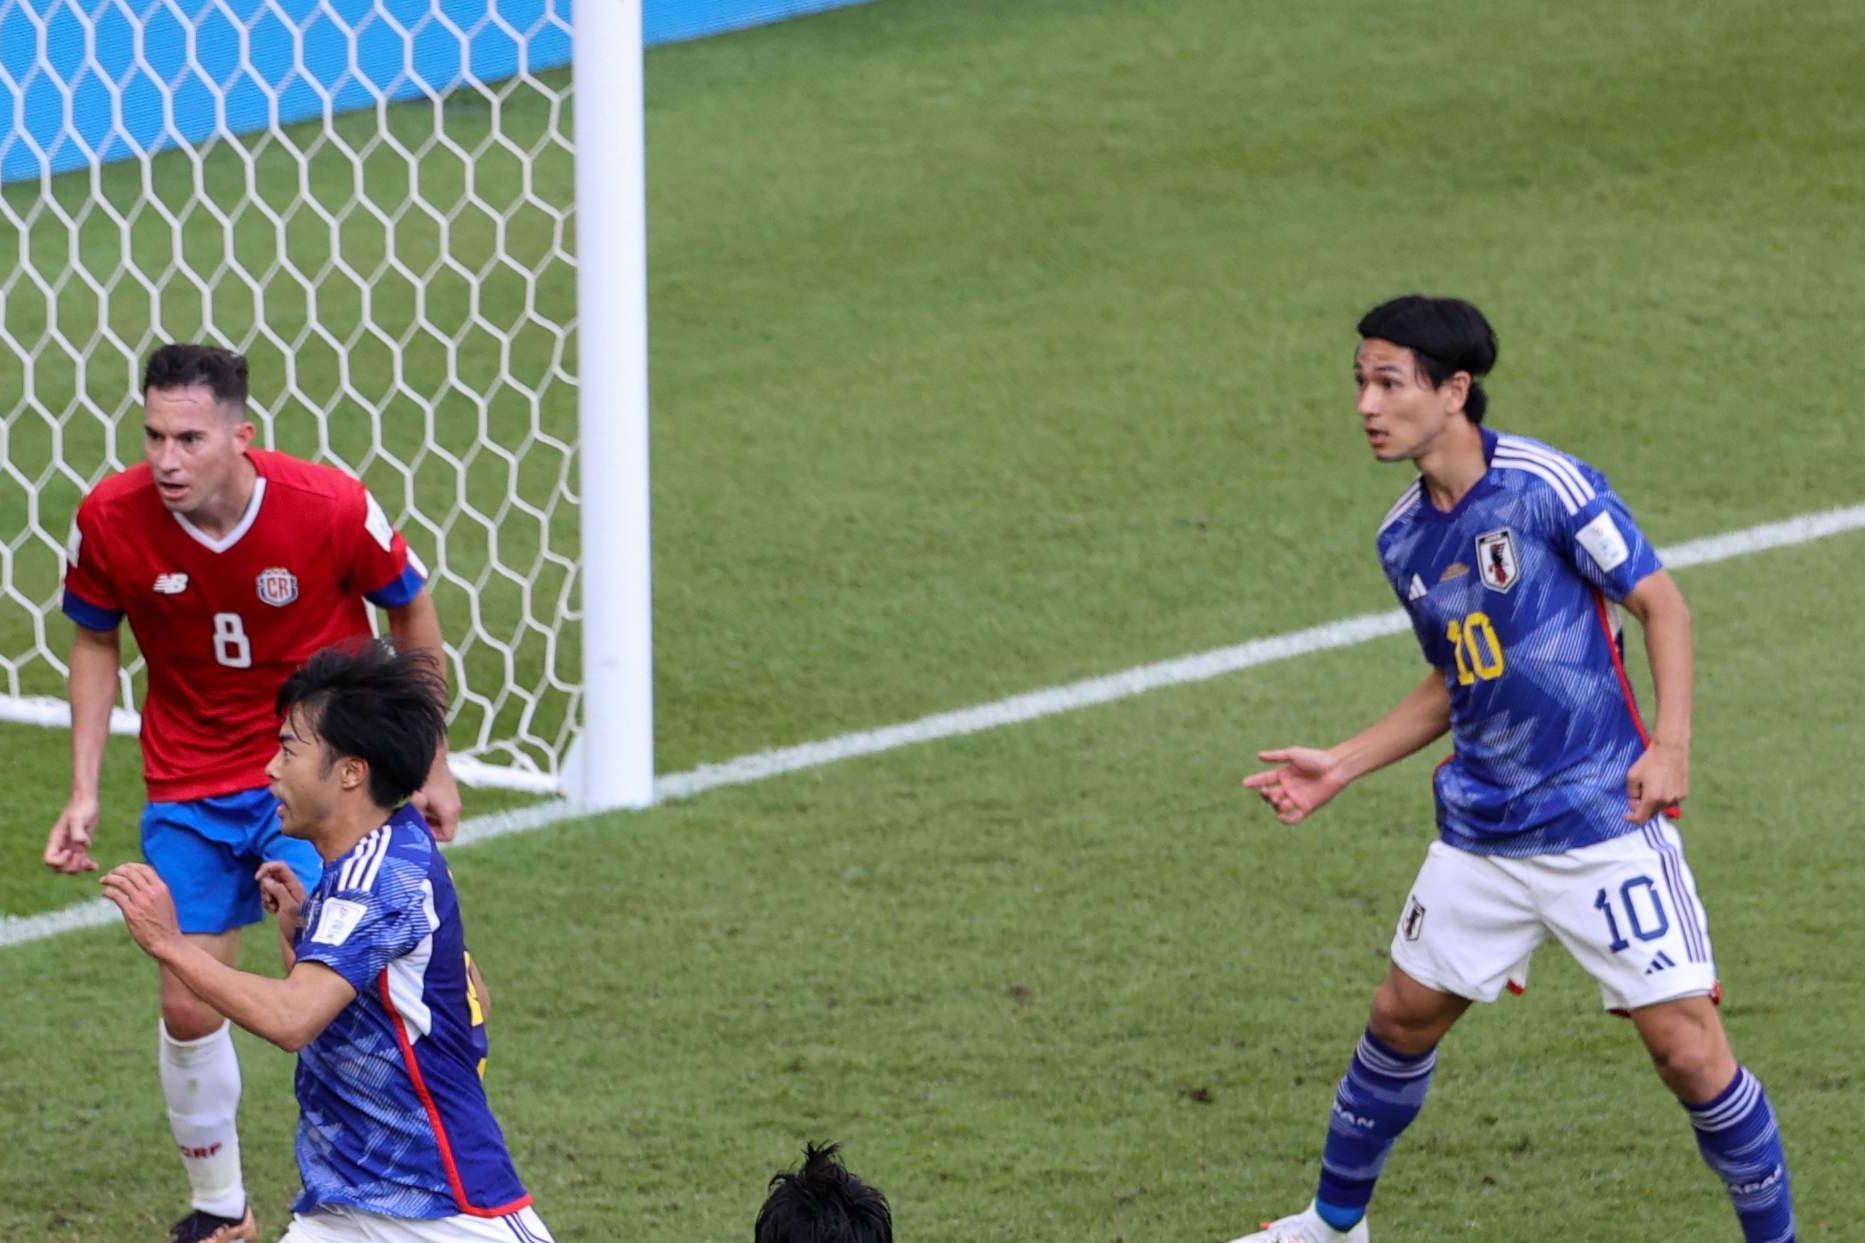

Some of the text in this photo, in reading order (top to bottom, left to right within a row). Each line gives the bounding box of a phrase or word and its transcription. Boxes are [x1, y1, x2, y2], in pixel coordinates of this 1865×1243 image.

[213, 612, 253, 668] 8
[1446, 611, 1505, 686] 10
[1594, 875, 1670, 954] 10
